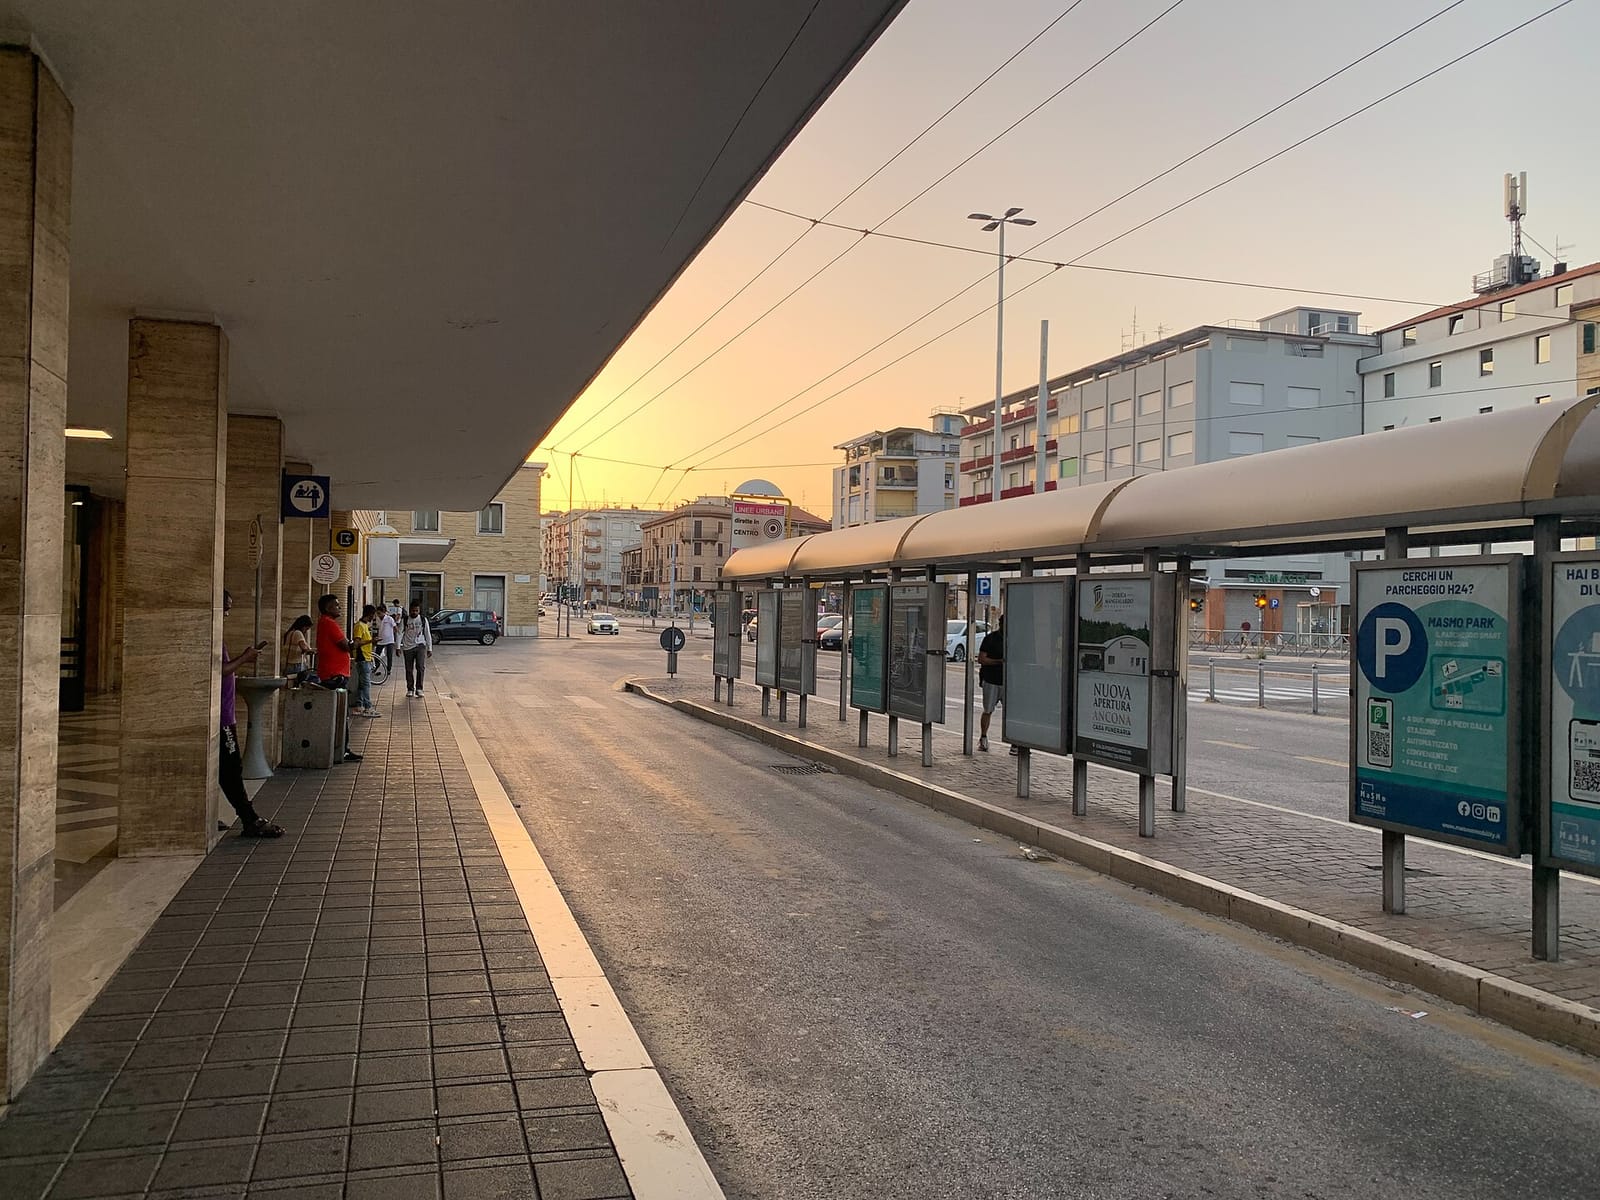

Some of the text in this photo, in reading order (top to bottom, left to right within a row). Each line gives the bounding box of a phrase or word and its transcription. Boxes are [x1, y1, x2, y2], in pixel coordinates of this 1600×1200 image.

[735, 505, 784, 516] LINEE URBANE
[734, 517, 752, 525] dirette
[733, 529, 759, 537] CENTRO
[1402, 570, 1453, 582] CERCHI UN
[1566, 568, 1588, 580] HAI
[979, 579, 990, 595] P
[1385, 583, 1474, 595] PARCHEGGIO H24?
[1580, 584, 1593, 596] DI
[1271, 599, 1278, 608] P
[1427, 617, 1495, 629] MASMO PARK
[1375, 617, 1411, 678] P
[1093, 682, 1131, 700] NUOVA
[1093, 698, 1131, 712] APERTURA
[1092, 710, 1131, 726] ANCONA
